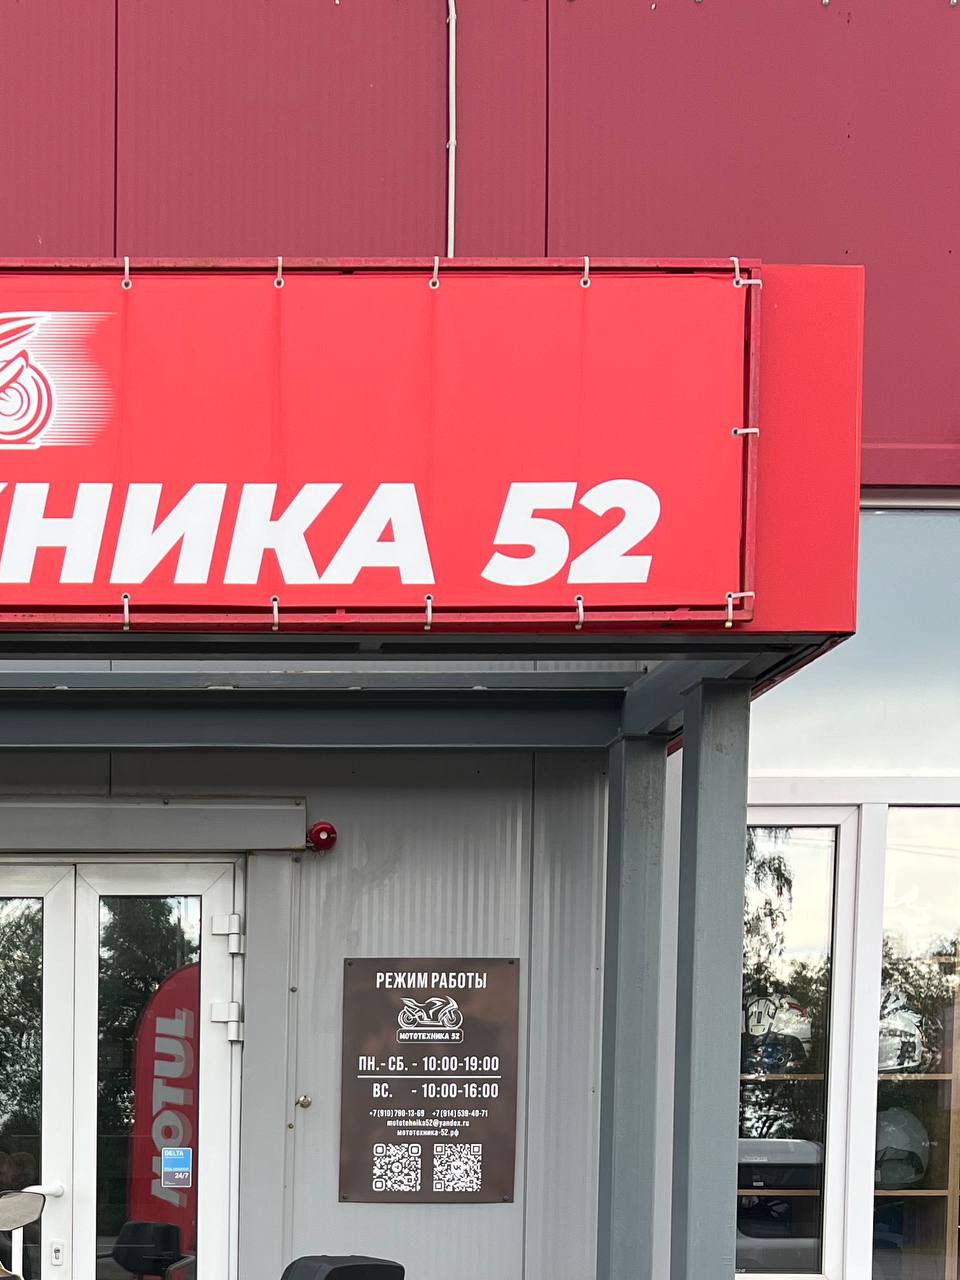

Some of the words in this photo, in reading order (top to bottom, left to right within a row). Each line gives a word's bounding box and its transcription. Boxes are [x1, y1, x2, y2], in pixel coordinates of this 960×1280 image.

[481, 479, 662, 587] 52
[376, 972, 428, 989] РЕЖИМ
[431, 972, 487, 989] РАБОТЫ
[399, 1032, 449, 1040] МОТОТЕХНИКА
[451, 1032, 460, 1040] 52
[422, 1056, 500, 1072] 10:00-19:00
[372, 1083, 393, 1098] ВС.
[421, 1083, 499, 1098] 10:00-16:00
